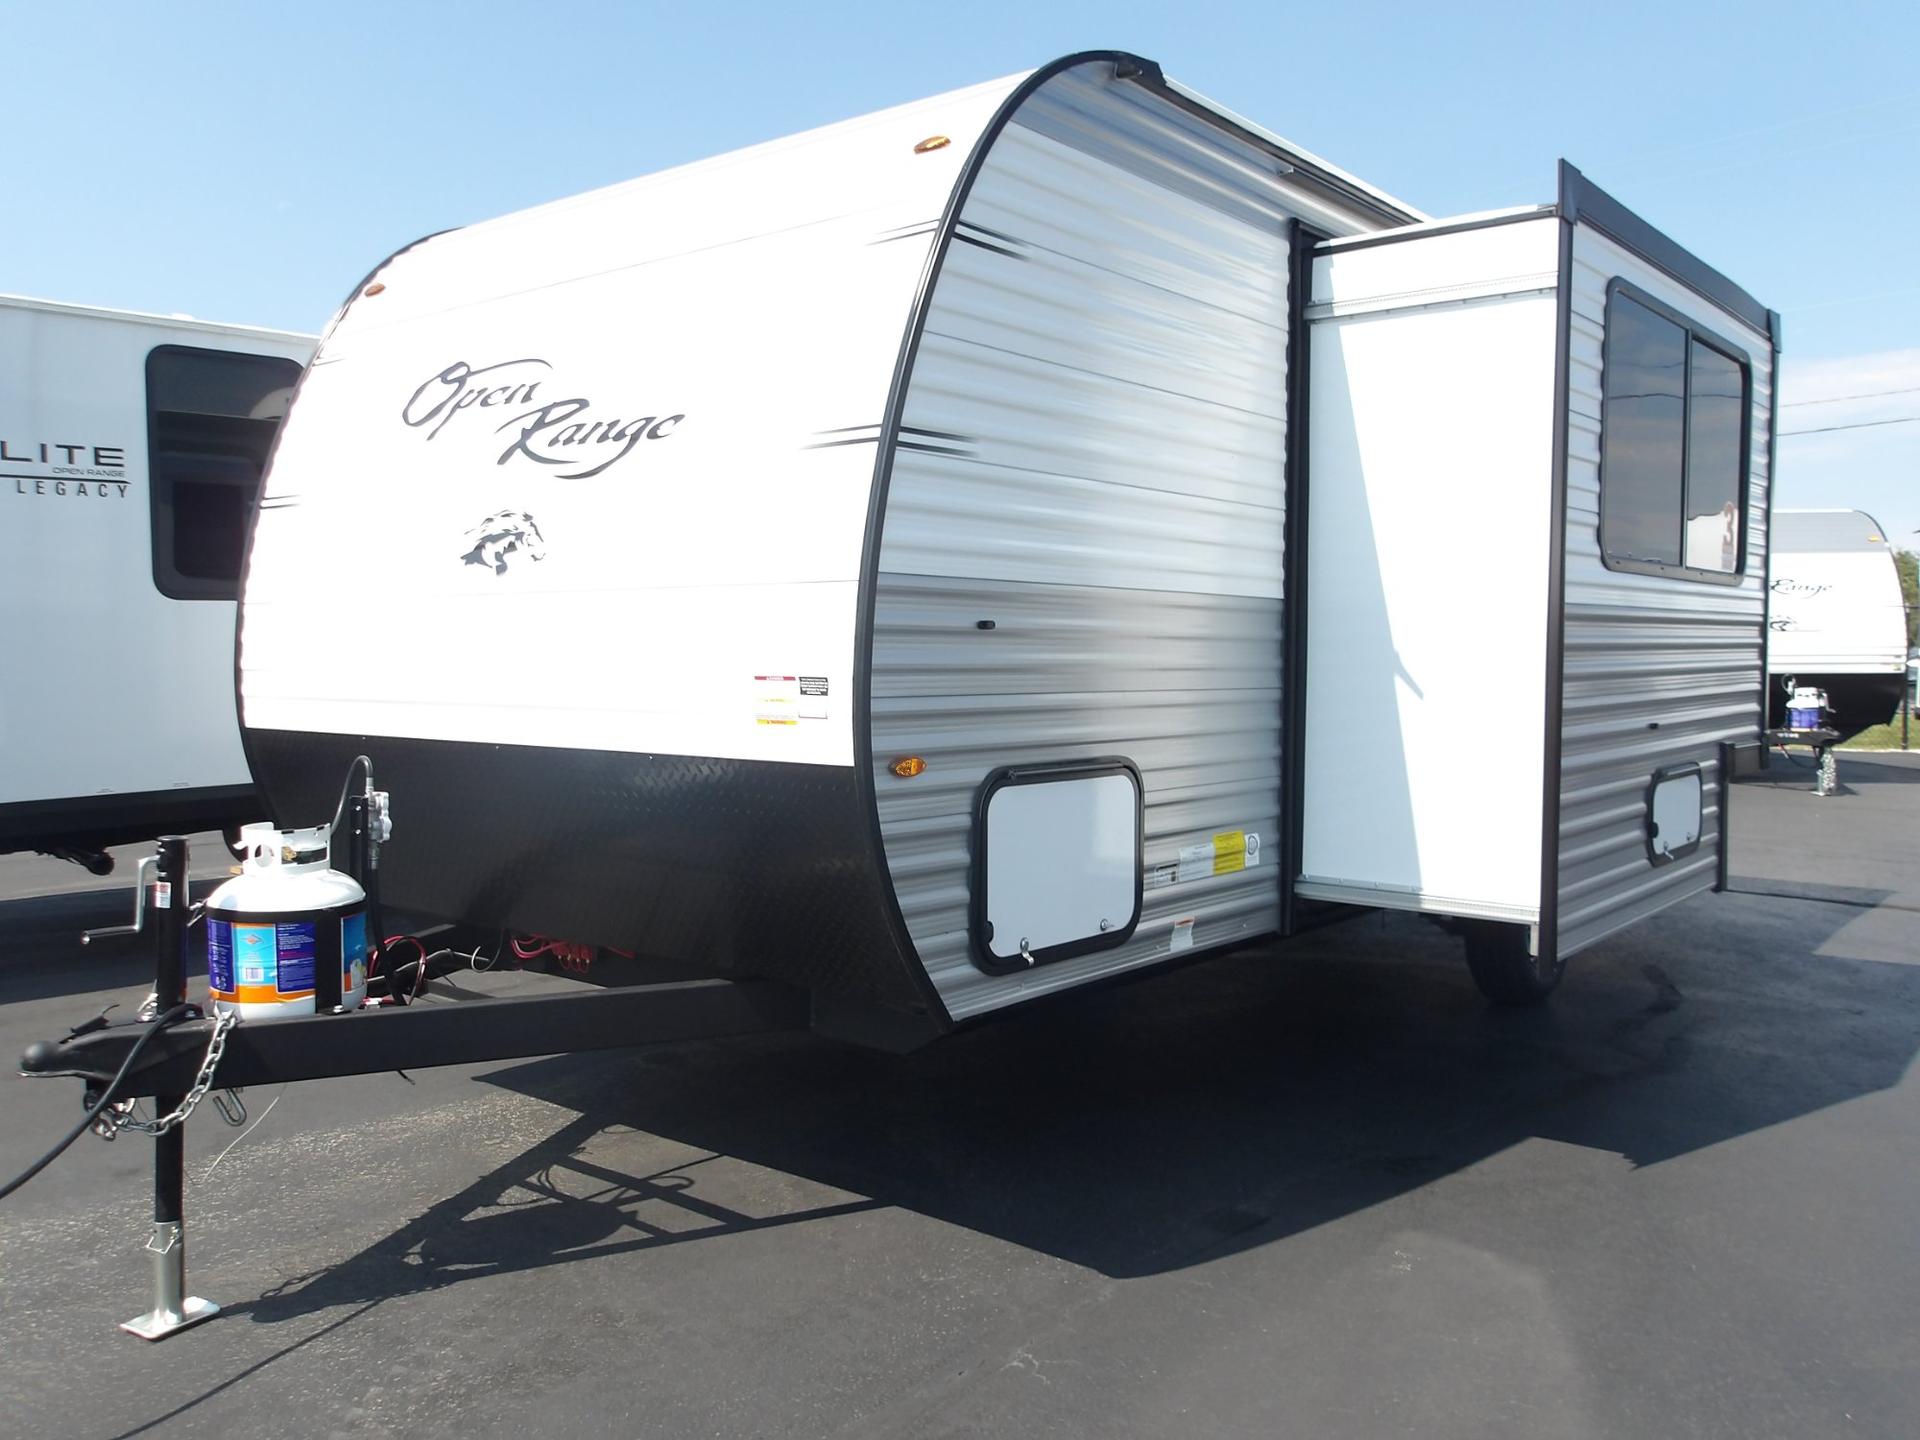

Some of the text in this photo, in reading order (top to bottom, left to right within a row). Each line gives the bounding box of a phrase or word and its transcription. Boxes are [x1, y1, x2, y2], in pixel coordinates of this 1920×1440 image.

[402, 358, 553, 441] Open
[494, 398, 685, 480] Range
[0, 440, 125, 468] LITE
[52, 466, 126, 478] OPEN RANGE
[16, 479, 128, 498] LEGACY
